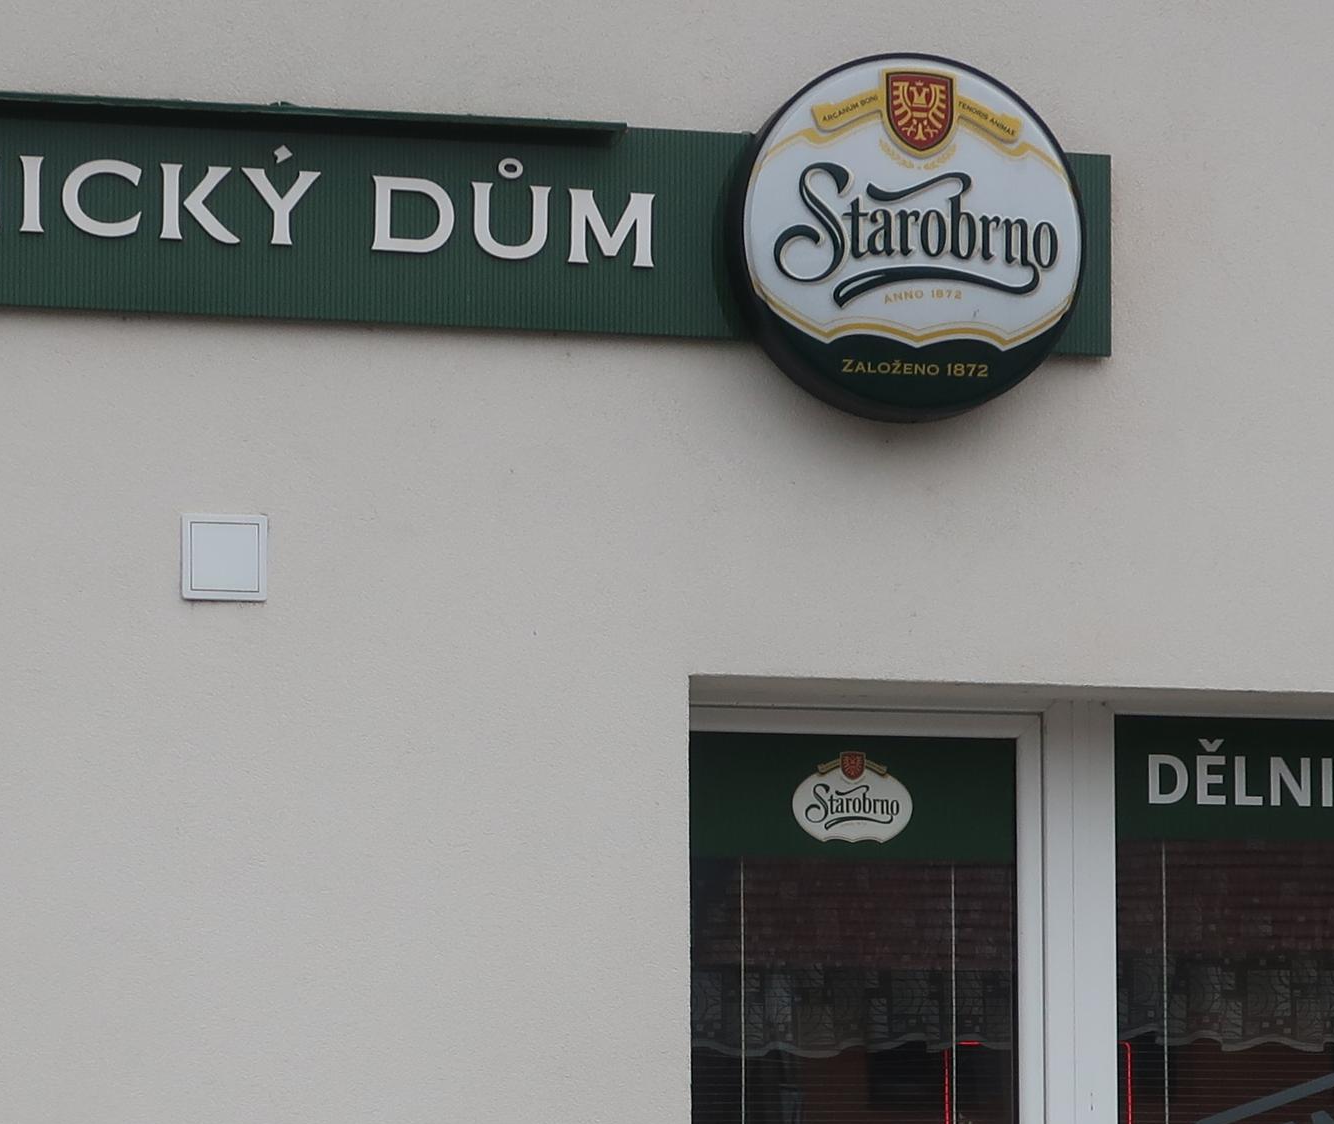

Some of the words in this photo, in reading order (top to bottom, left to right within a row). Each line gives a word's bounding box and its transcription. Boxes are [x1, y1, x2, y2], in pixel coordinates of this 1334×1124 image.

[371, 157, 656, 268] DŮM
[773, 162, 1059, 300] Starobrno
[884, 289, 924, 304] ANNO
[842, 359, 940, 376] ZALOŽENO
[947, 362, 989, 377] 1872
[805, 783, 900, 830] Starobrno
